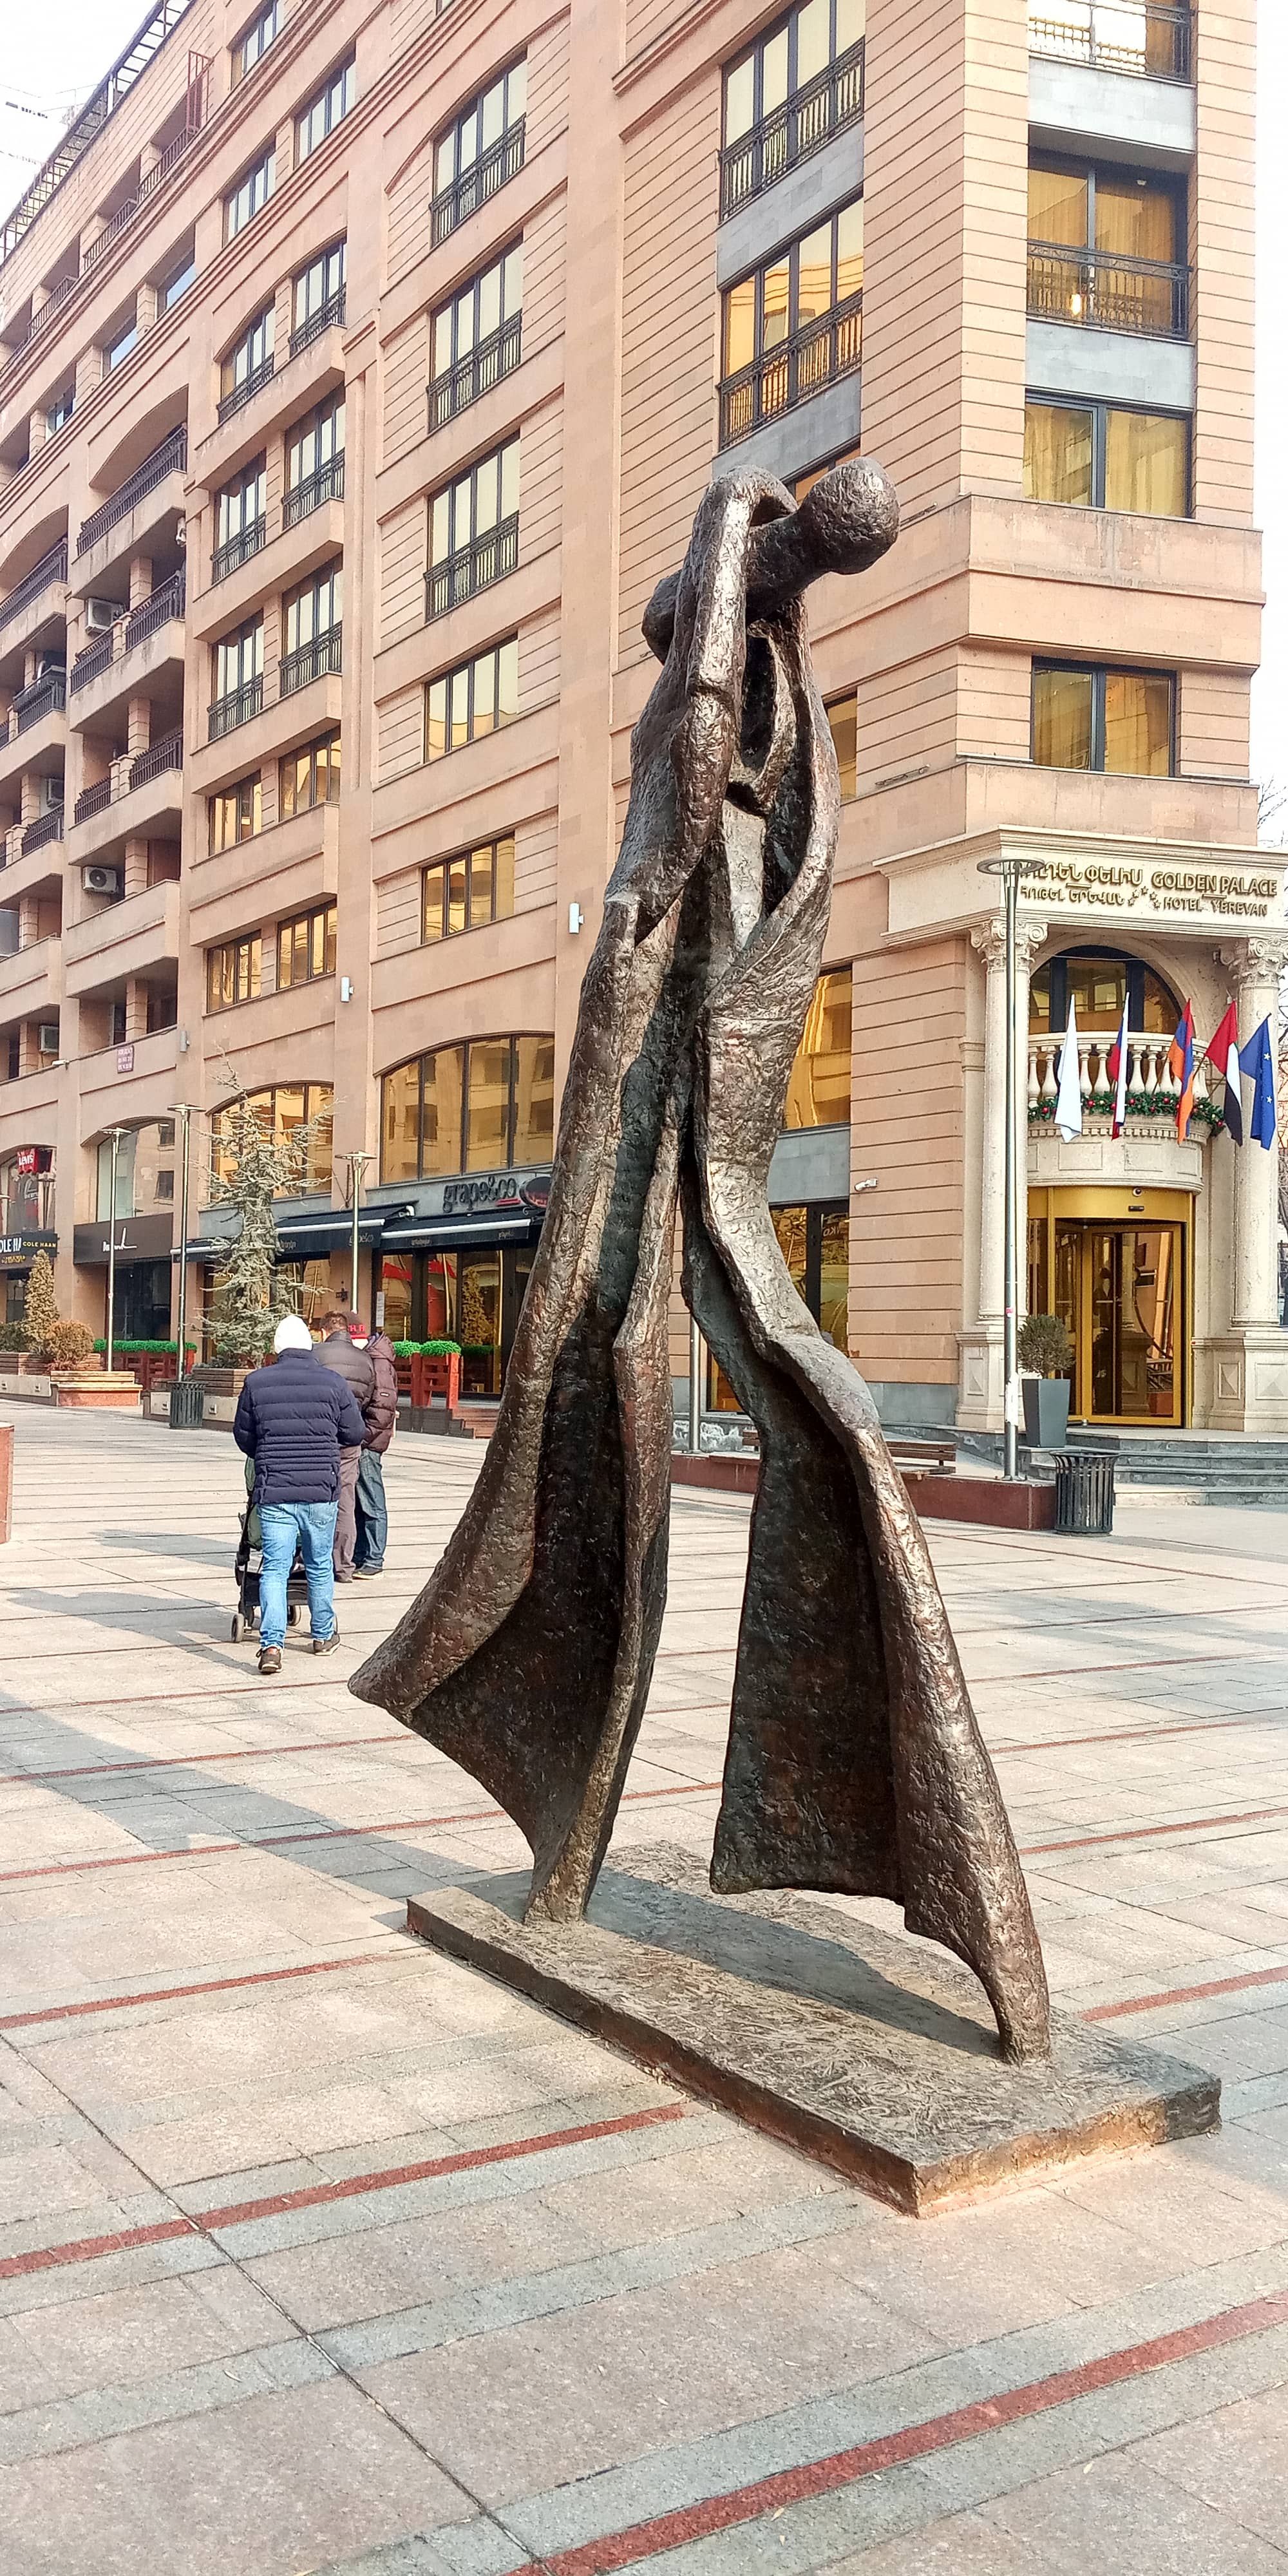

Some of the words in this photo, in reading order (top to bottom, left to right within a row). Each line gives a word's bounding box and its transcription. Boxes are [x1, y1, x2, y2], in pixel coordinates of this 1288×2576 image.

[1151, 871, 1217, 893] GOLDEN
[1220, 876, 1278, 897] PALACE
[1164, 897, 1204, 911] HOTEL
[1211, 899, 1268, 917] YEREVAN
